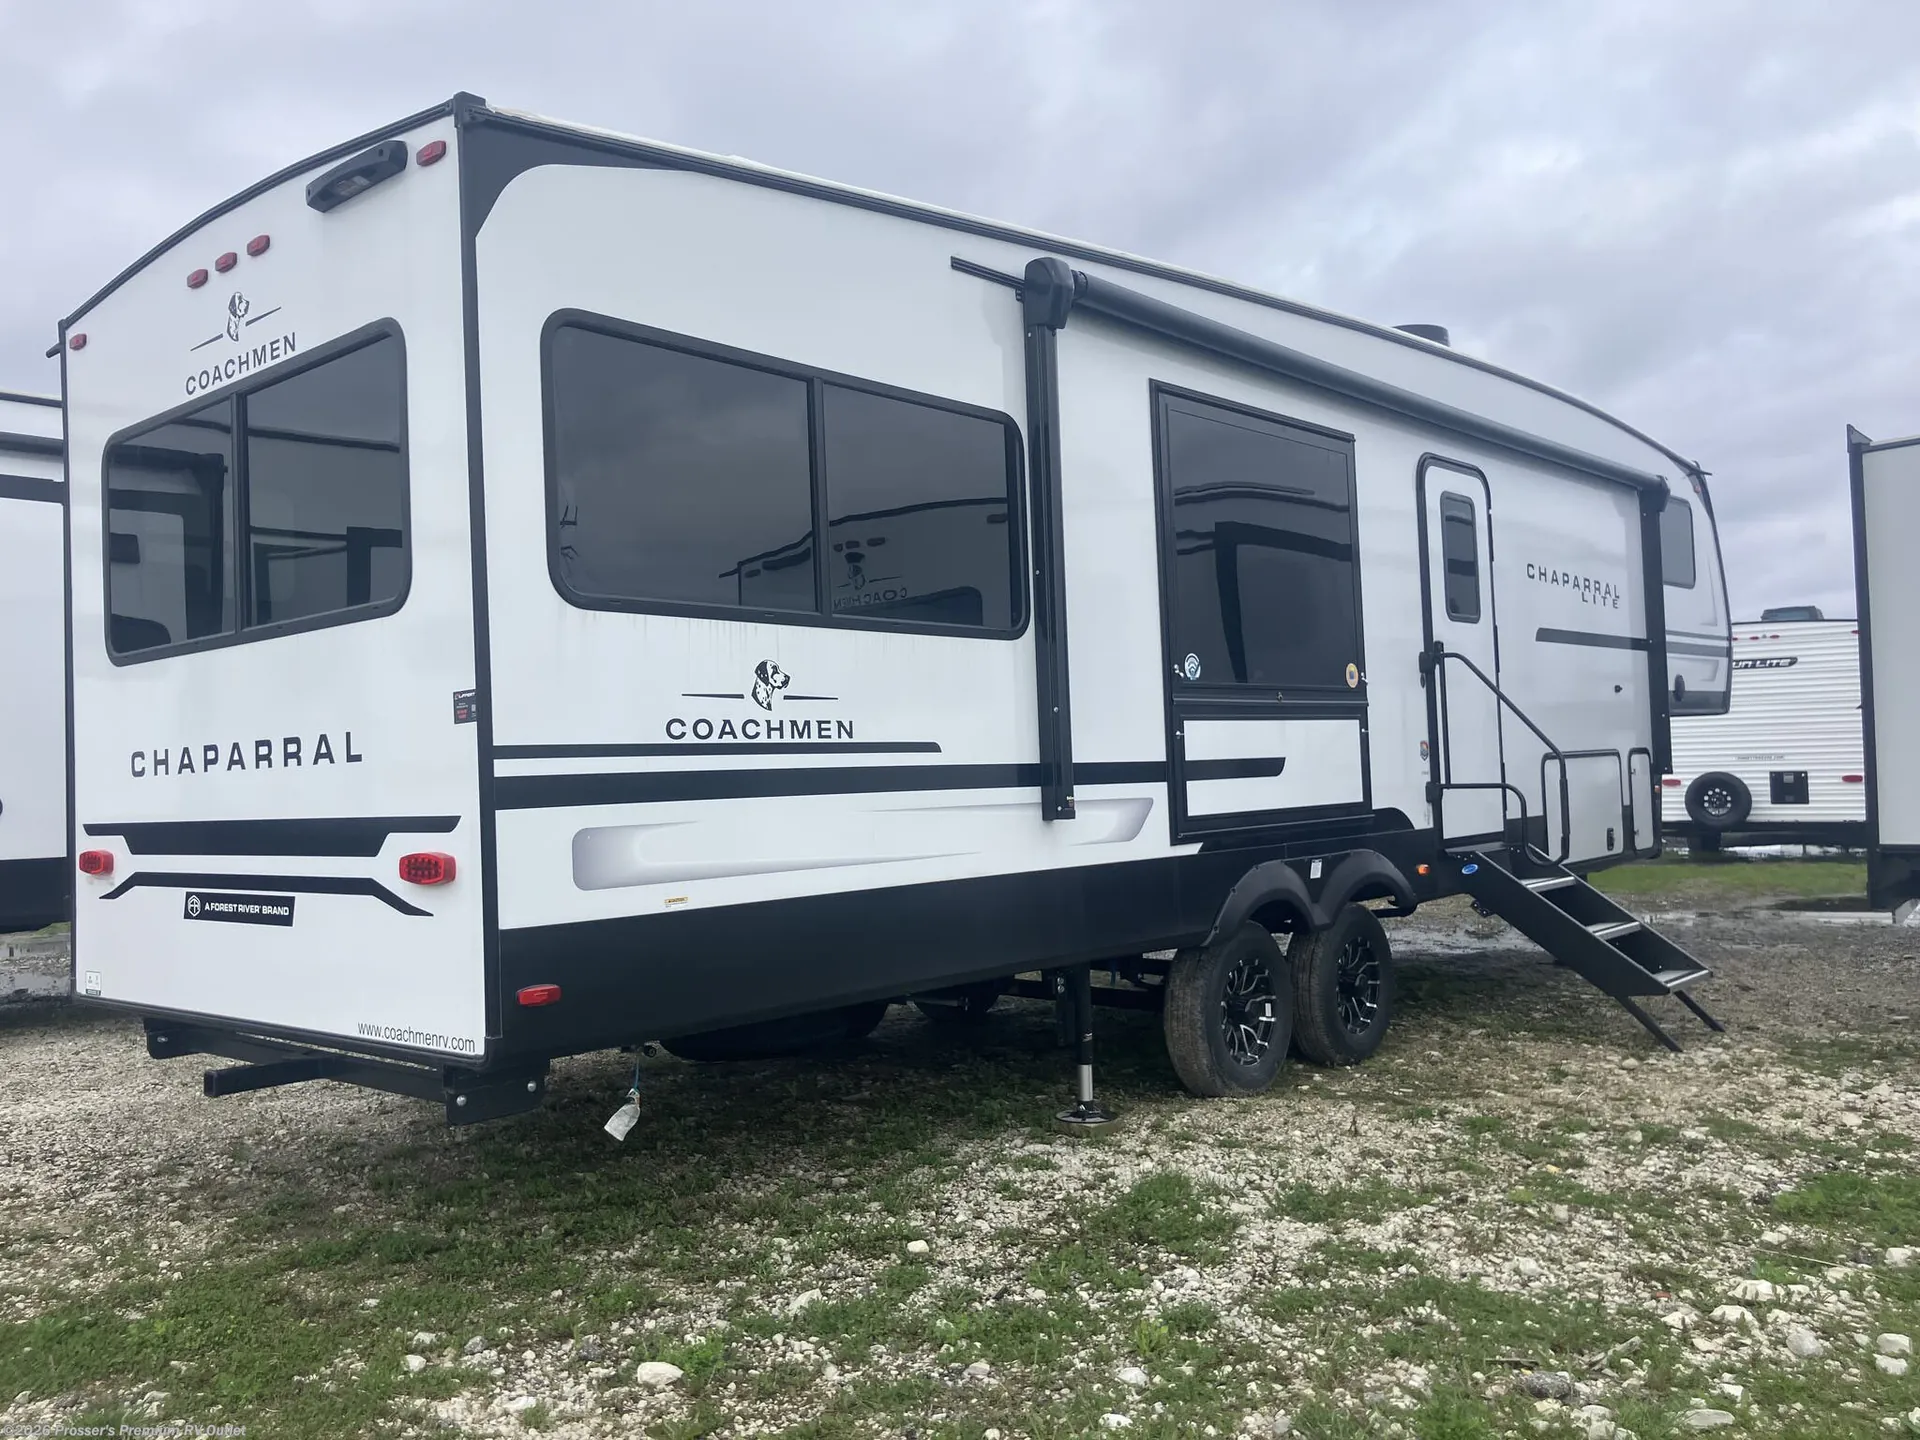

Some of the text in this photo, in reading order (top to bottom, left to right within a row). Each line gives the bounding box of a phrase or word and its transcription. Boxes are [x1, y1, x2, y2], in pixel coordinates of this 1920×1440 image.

[185, 332, 296, 395] COACHMEN
[1526, 563, 1620, 599] CHAPARRAL
[1581, 591, 1619, 610] LITE
[1732, 658, 1791, 669] UN LITE
[665, 717, 855, 741] COACHMEN
[131, 731, 363, 778] CHAPARRAL
[204, 902, 211, 911] A
[211, 902, 237, 912] FOREST
[262, 906, 289, 915] BRAND
[358, 1021, 476, 1053] www.coachmenrv.com
